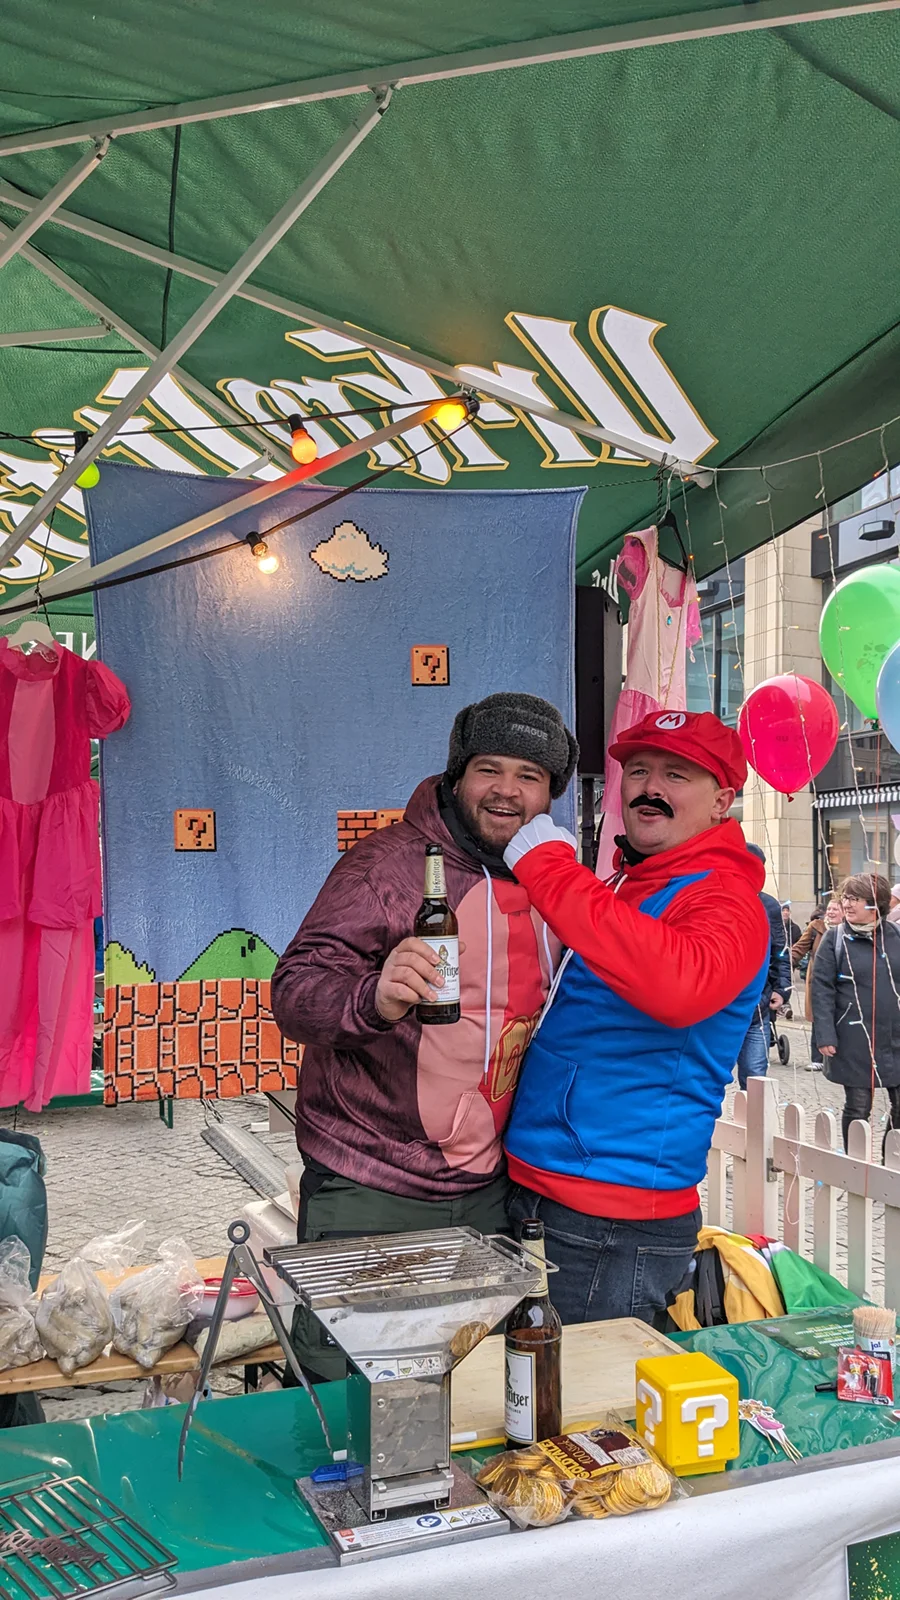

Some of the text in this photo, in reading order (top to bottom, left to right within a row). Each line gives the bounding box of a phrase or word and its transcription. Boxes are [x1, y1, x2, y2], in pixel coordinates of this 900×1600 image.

[658, 714, 681, 727] M
[511, 723, 548, 740] PRAGUE
[870, 1341, 881, 1350] ja!
[573, 1450, 594, 1464] 100
